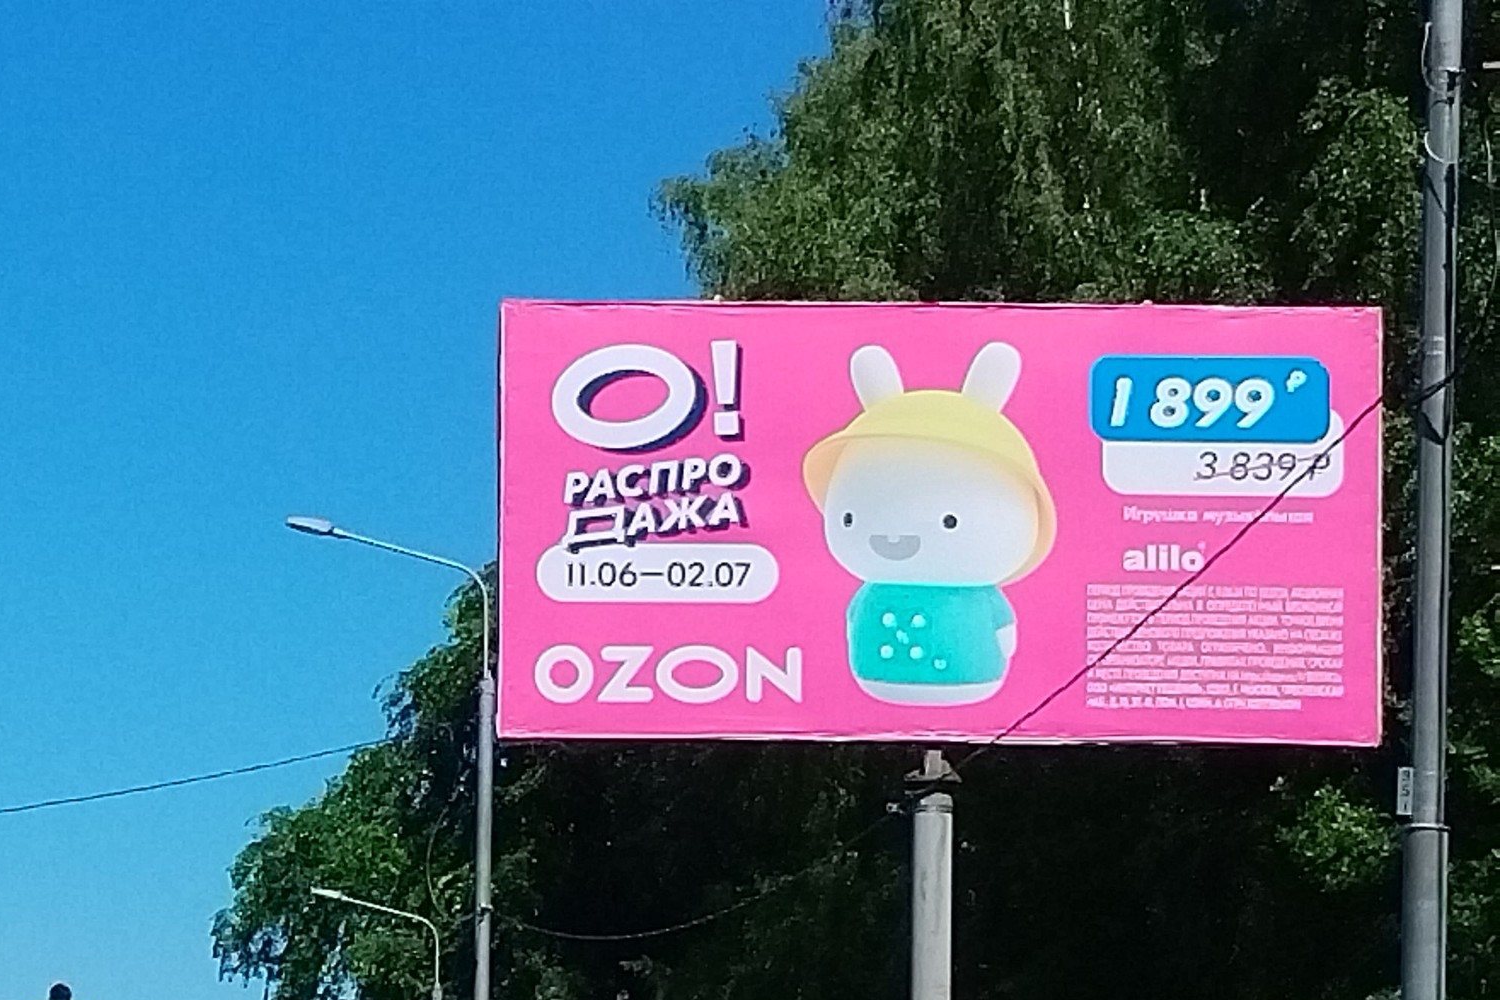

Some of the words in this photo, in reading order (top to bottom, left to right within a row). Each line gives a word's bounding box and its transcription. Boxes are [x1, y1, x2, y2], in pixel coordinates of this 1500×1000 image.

[564, 453, 747, 507] РАСПРО
[561, 493, 746, 551] ДАЖА
[534, 644, 802, 704] OZON
